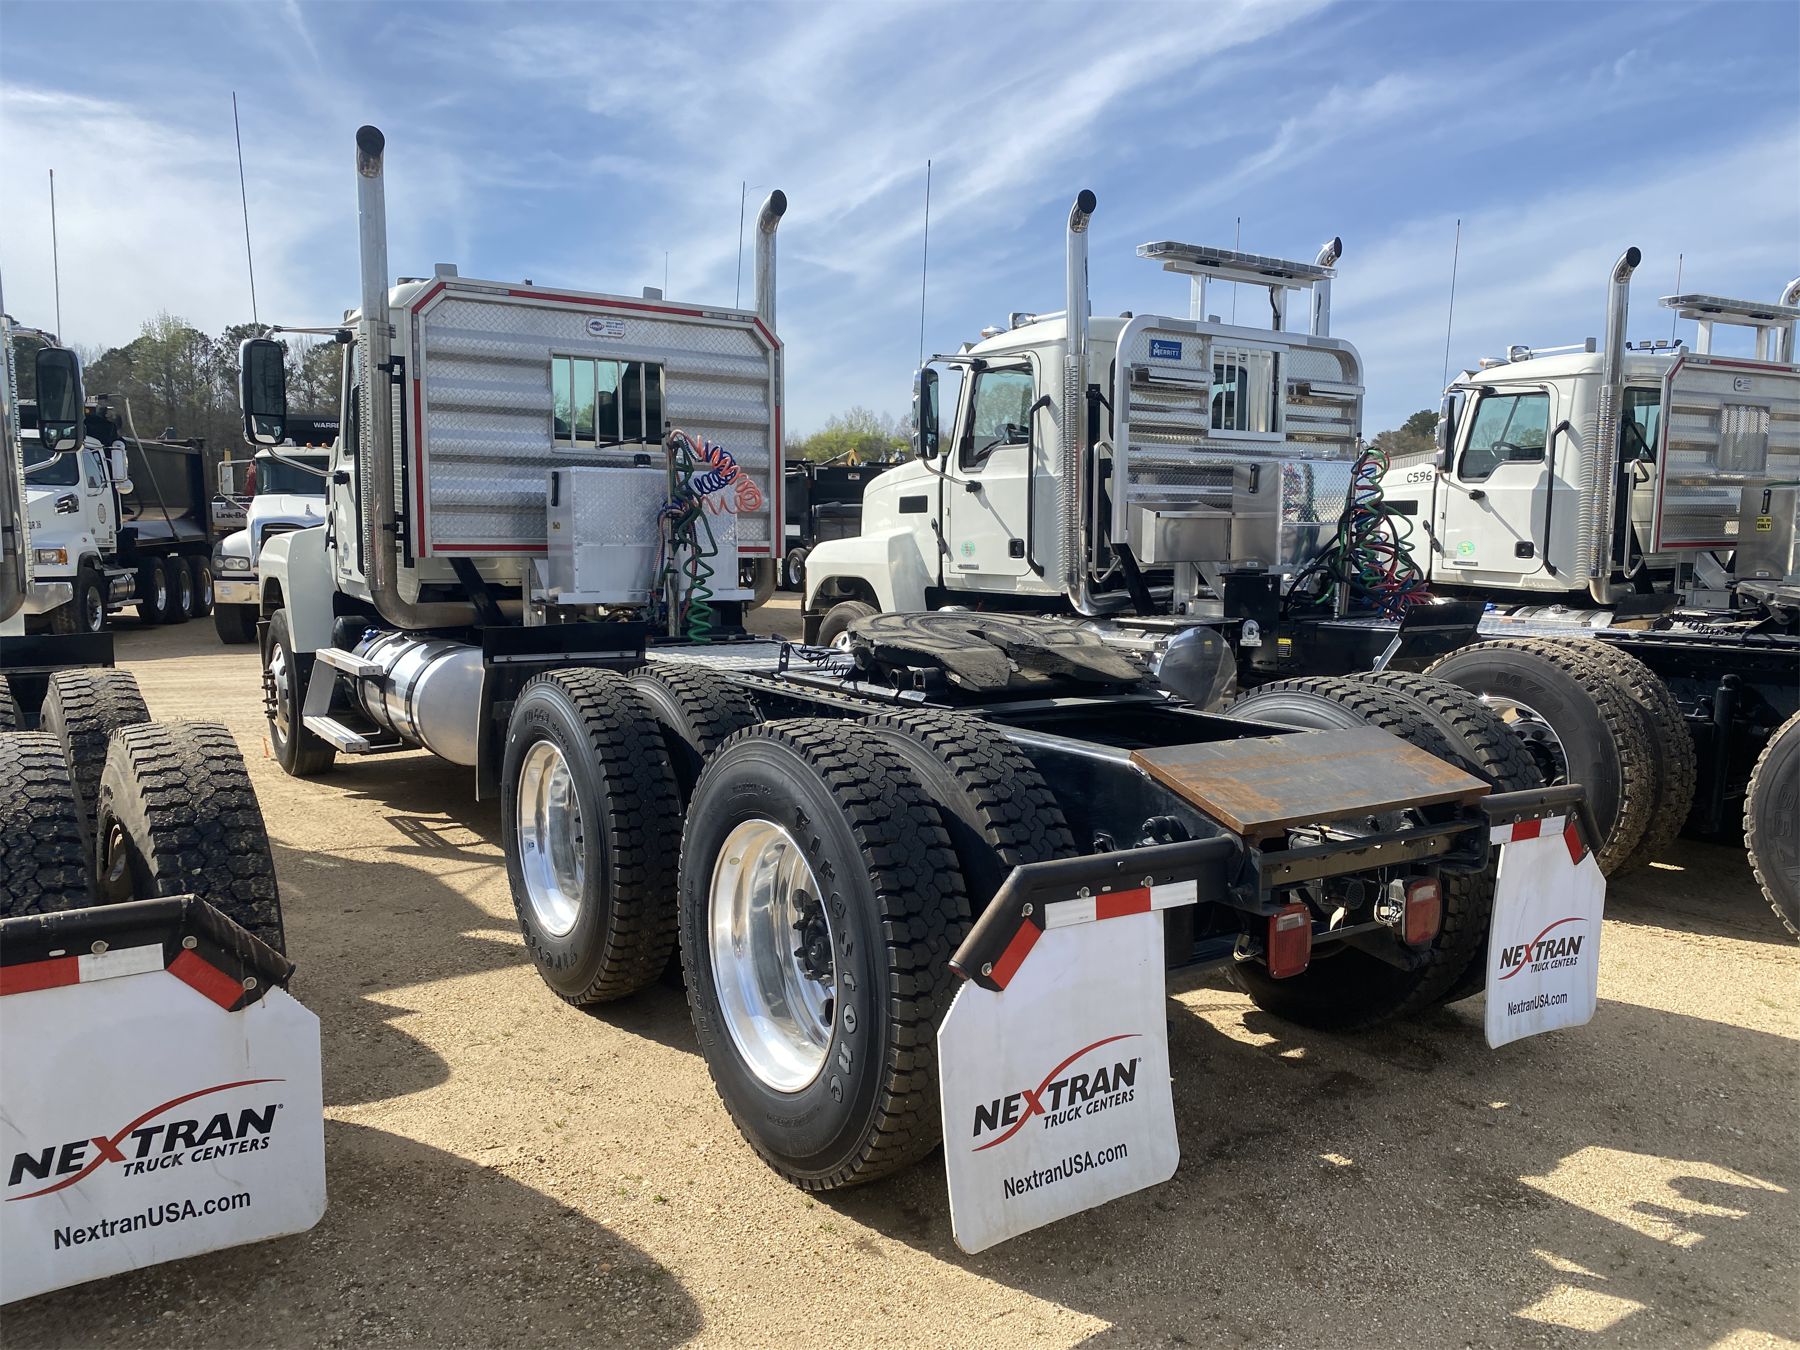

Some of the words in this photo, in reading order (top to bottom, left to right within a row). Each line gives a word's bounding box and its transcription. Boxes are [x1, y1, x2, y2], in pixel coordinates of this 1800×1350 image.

[1153, 349, 1180, 357] MERRITT
[1406, 470, 1433, 483] C596
[1499, 935, 1583, 970] NEXTRAN
[1530, 961, 1549, 974] TRUCK
[1550, 956, 1579, 969] CENTERS
[1507, 992, 1568, 1017] NextranUSA.com
[972, 1057, 1138, 1138] NEXTRAN
[1043, 1105, 1082, 1130] TRUCK
[1085, 1088, 1135, 1116] CENTERS
[7, 1103, 278, 1187] NEXTRAN
[122, 1152, 184, 1178] TRUCK
[190, 1136, 270, 1163] CENTERS
[1003, 1142, 1128, 1200] NextranUSA.com
[53, 1191, 251, 1251] NextranUSA.com
